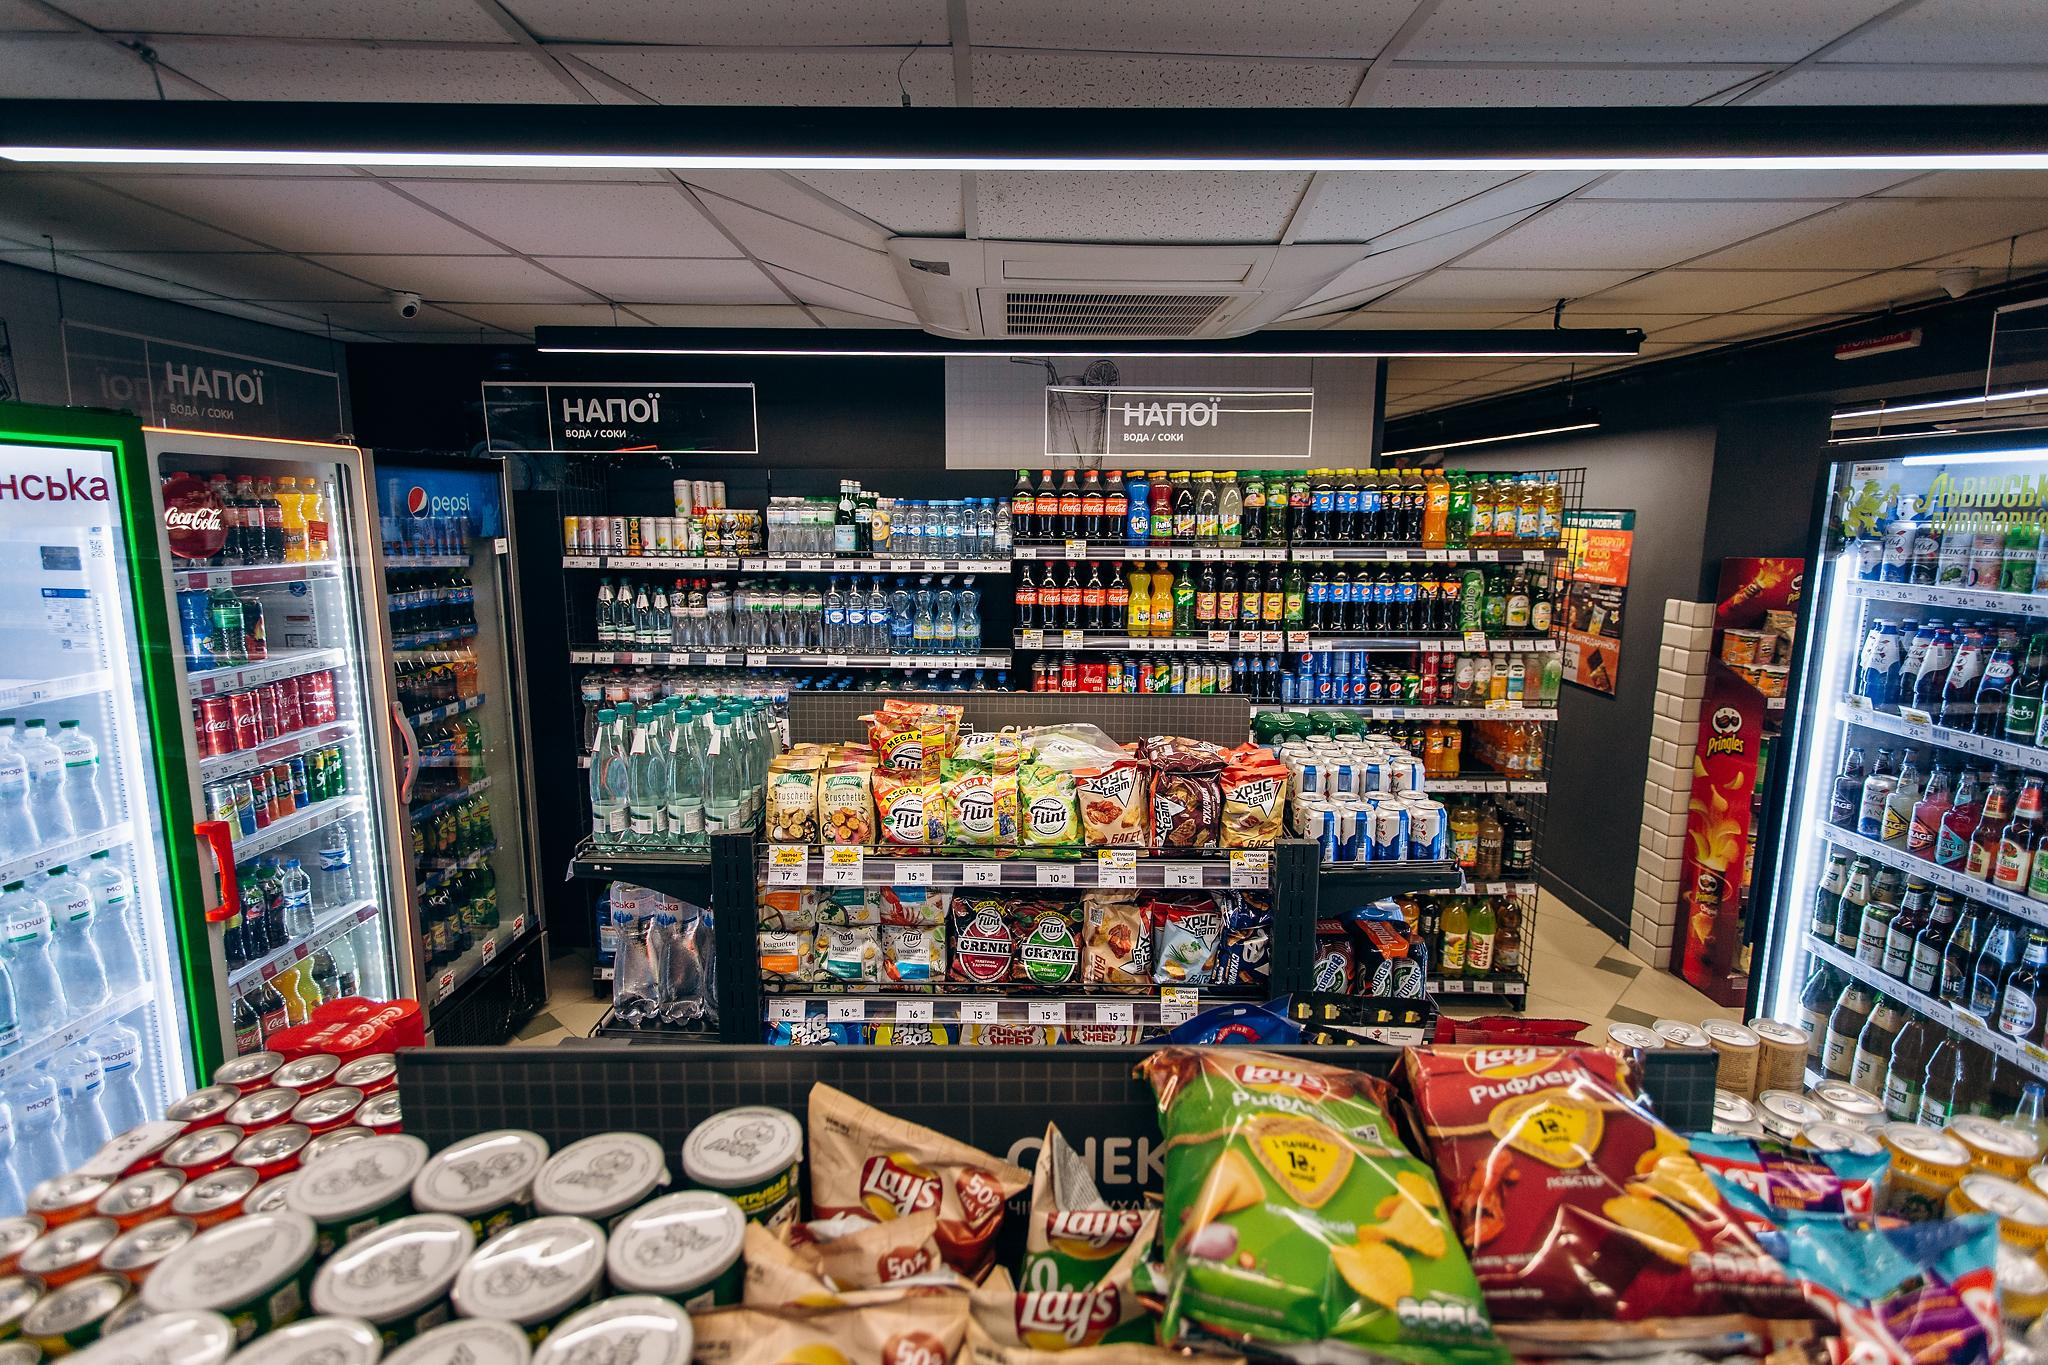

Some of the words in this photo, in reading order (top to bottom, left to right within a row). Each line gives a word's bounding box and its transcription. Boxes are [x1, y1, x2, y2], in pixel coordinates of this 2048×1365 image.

[166, 361, 264, 406] НАПОЇ
[170, 403, 200, 418] ВОДА
[207, 408, 234, 420] СОКИ
[563, 392, 661, 423] НАПОЇ
[1123, 396, 1222, 427] НАПОЇ
[565, 430, 592, 439] ВОДА
[600, 430, 627, 438] СОКИ
[1123, 433, 1150, 443] ВОДА
[1157, 433, 1184, 442] СОКИ
[431, 493, 471, 515] pepsi
[164, 507, 223, 531] Coca-Cola
[1897, 591, 1907, 599] 26
[1957, 597, 1968, 605] 26
[1985, 600, 1996, 608] 26
[1909, 728, 1919, 736] 24
[887, 733, 914, 748] MEGA
[1958, 741, 1969, 749] 26
[1706, 733, 1745, 758] Pringles
[1992, 748, 2004, 757] 22
[2029, 757, 2042, 767] 20
[1101, 780, 1131, 797] team
[774, 790, 813, 800] Bruschette
[824, 792, 866, 802] Bruschette
[1247, 791, 1274, 806] team
[1031, 808, 1067, 826] flint
[1872, 849, 1881, 857] 27
[1900, 860, 1910, 868] 27
[782, 872, 791, 881] 17
[837, 871, 846, 880] 17
[908, 872, 917, 881] 15
[976, 872, 986, 881] 15
[1049, 874, 1059, 883] 10
[1118, 875, 1126, 884] 11
[1177, 875, 1187, 884] 15
[1930, 872, 1940, 880] 27
[1250, 876, 1258, 885] 11
[1965, 884, 1974, 892] 31
[2021, 906, 2031, 915] 31
[978, 914, 1000, 926] flint
[1041, 922, 1064, 935] flint
[902, 931, 922, 943] flint
[763, 940, 796, 949] baguette
[960, 939, 1012, 954] GRENKI
[1024, 948, 1076, 961] GRENKI
[781, 1008, 791, 1017] 16
[840, 1008, 850, 1017] 16
[909, 1010, 918, 1019] 16
[973, 1011, 983, 1020] 15
[1041, 1011, 1050, 1020] 15
[1109, 1012, 1118, 1021] 15
[1180, 1012, 1188, 1021] 11
[1930, 1008, 1940, 1017] 20
[791, 1015, 828, 1038] BIG
[988, 1025, 1038, 1037] FUNNY
[801, 1027, 832, 1045] BOB
[902, 1030, 933, 1045] BOB
[1082, 1031, 1117, 1043] SHEEP
[2031, 1062, 2041, 1072] 18
[1468, 1067, 1595, 1105] Рифлені
